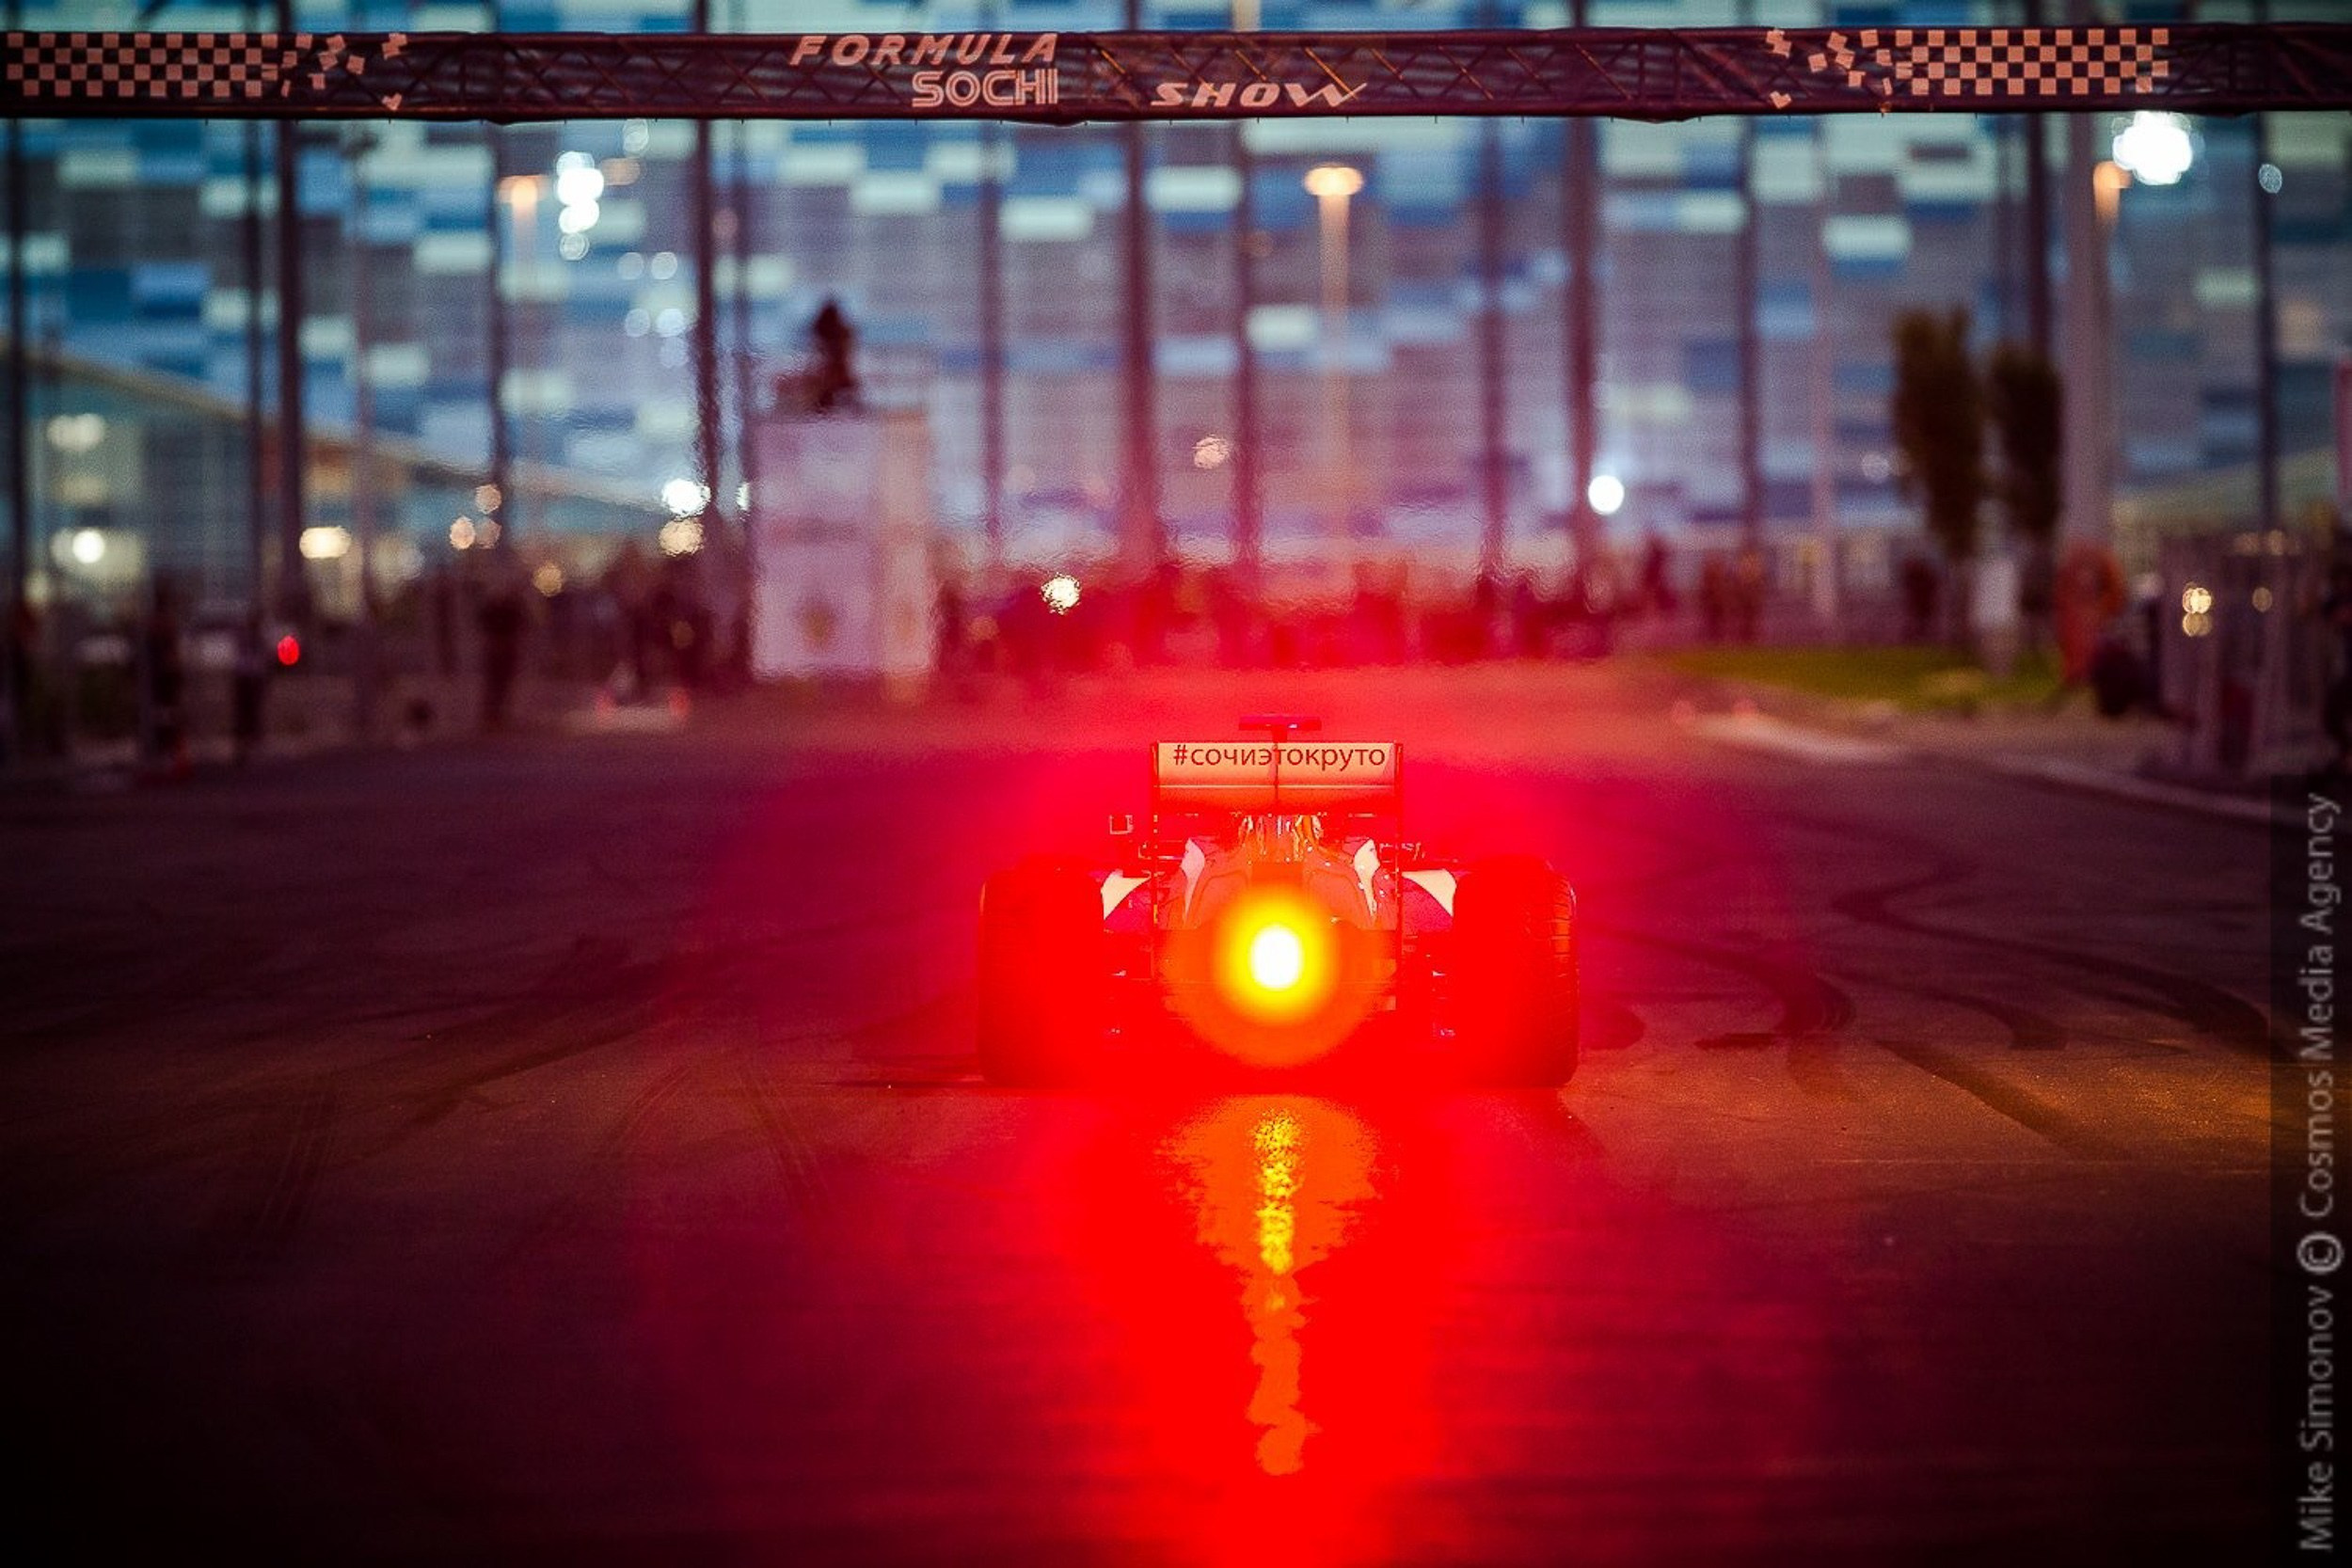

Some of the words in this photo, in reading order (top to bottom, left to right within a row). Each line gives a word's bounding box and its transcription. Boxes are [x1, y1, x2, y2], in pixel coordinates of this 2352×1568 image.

[789, 34, 1058, 66] FORMULA
[911, 69, 1059, 108] SOCHI
[1151, 82, 1368, 108] SHOW
[1172, 744, 1387, 772] #сочиэтокруто
